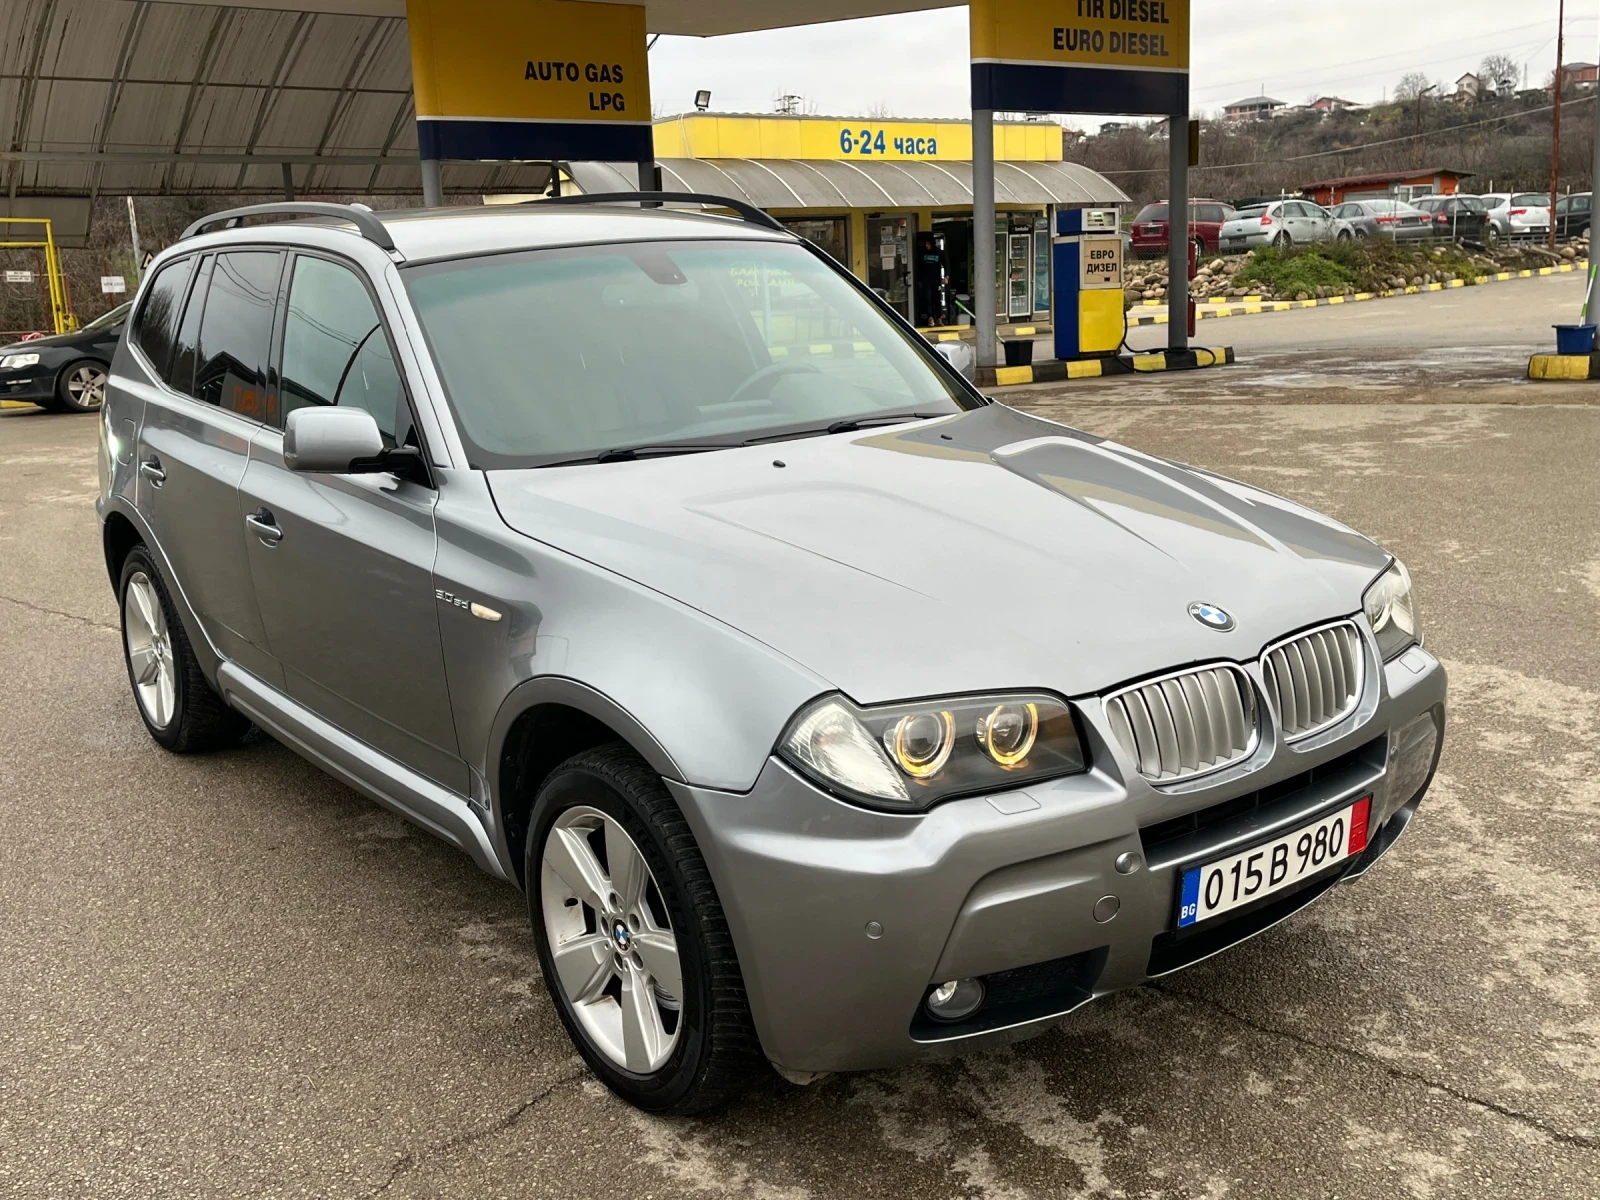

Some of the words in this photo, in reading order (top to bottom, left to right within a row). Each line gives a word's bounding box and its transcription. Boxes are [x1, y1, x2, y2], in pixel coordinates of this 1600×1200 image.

[1076, 0, 1105, 18] TIR
[1109, 0, 1170, 24] DIESEL
[1053, 27, 1104, 52] EURO
[1109, 31, 1169, 57] DIESEL
[524, 60, 580, 82] AUTO
[584, 63, 624, 84] GAS
[588, 91, 625, 112] LPG
[840, 128, 886, 155] 6-24
[893, 136, 937, 155] часа
[1090, 249, 1115, 260] ЕВРО
[1086, 262, 1117, 275] ДИЗЕЛ
[1181, 902, 1196, 919] BG
